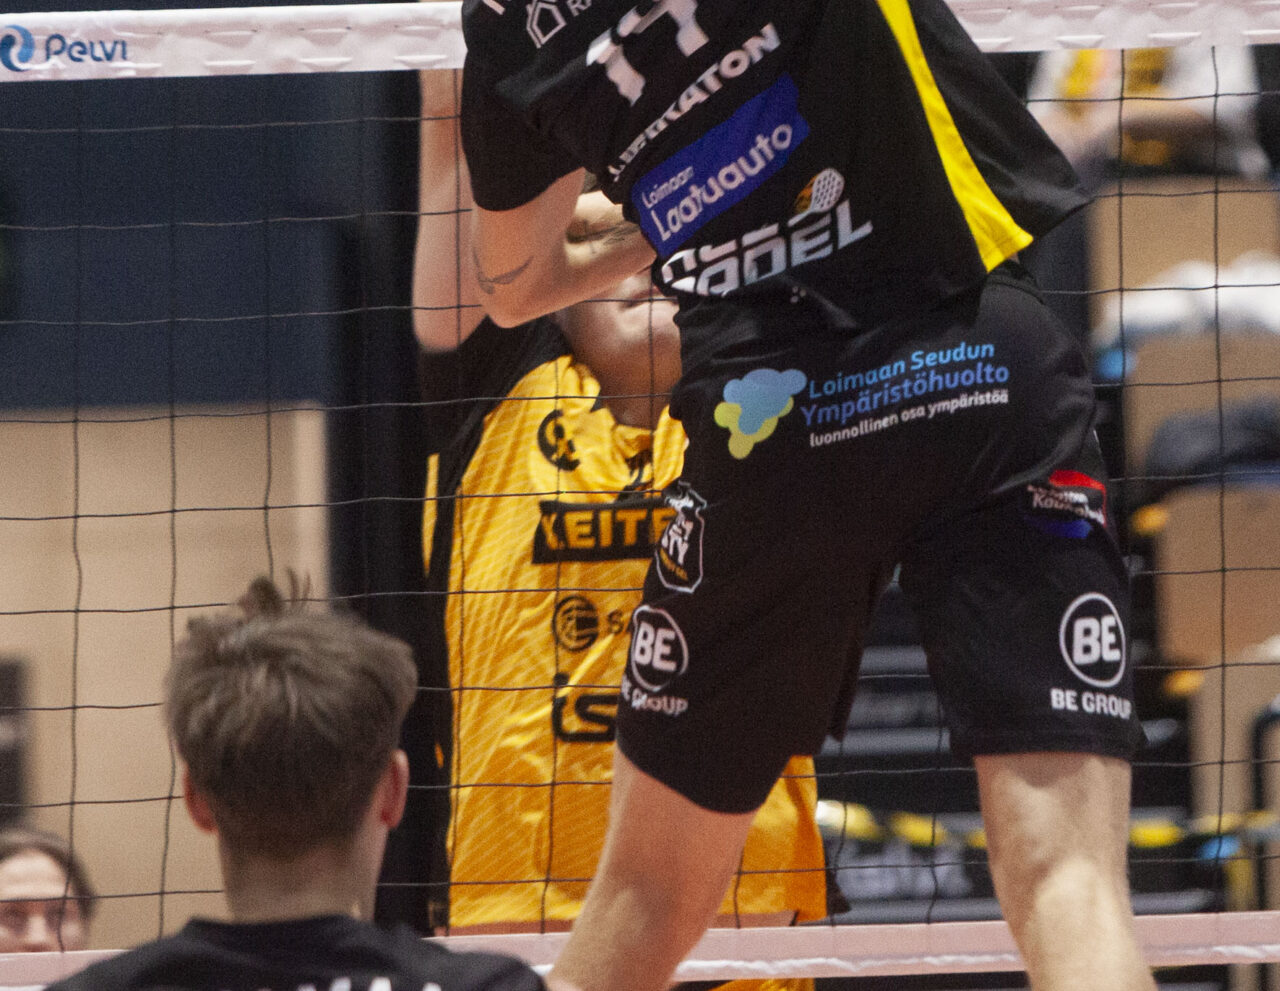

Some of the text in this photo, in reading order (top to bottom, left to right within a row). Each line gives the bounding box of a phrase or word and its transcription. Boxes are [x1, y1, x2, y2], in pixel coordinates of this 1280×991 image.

[642, 166, 694, 208] Loimaan
[650, 124, 793, 241] Laatuauto
[801, 362, 1009, 426] Ympäristöhuolto
[810, 342, 995, 398] Loimaan Seudun
[810, 389, 1009, 447] luonnollinen osa ympäristöä
[635, 621, 677, 671] BE
[1073, 615, 1121, 665] BE
[1050, 687, 1131, 719] BE GROUP
